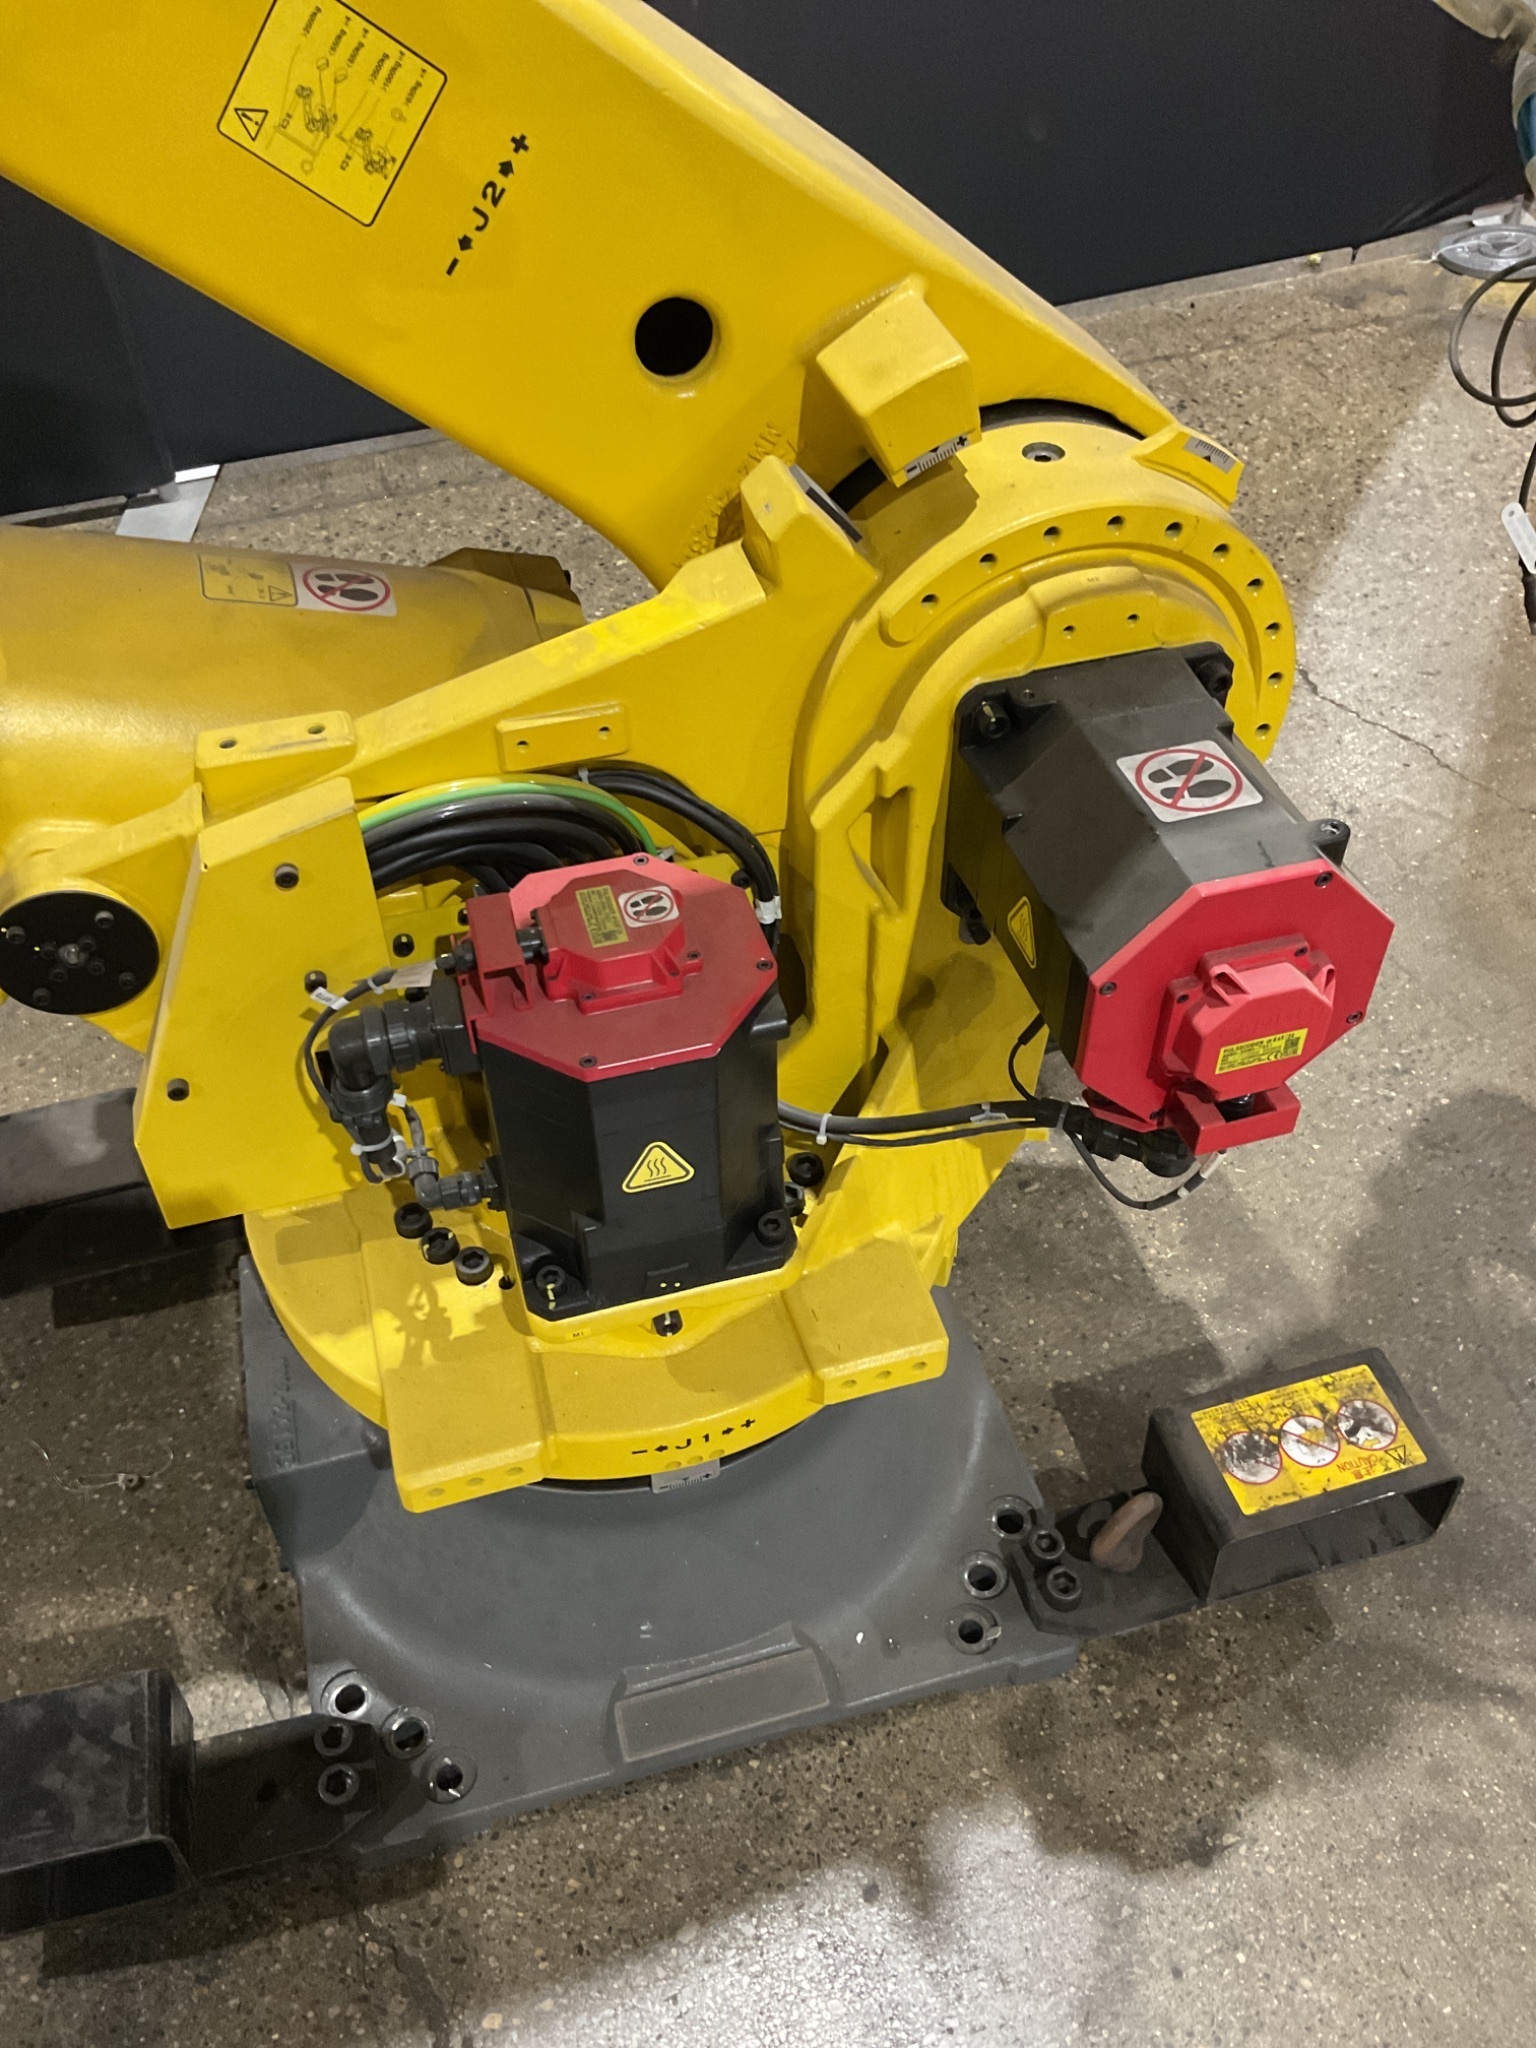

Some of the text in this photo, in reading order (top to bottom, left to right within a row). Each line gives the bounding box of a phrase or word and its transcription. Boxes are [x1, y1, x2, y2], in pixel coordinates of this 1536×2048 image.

[472, 180, 506, 232] J2
[674, 1433, 710, 1450] J1
[1337, 1453, 1380, 1473] CAUTION
